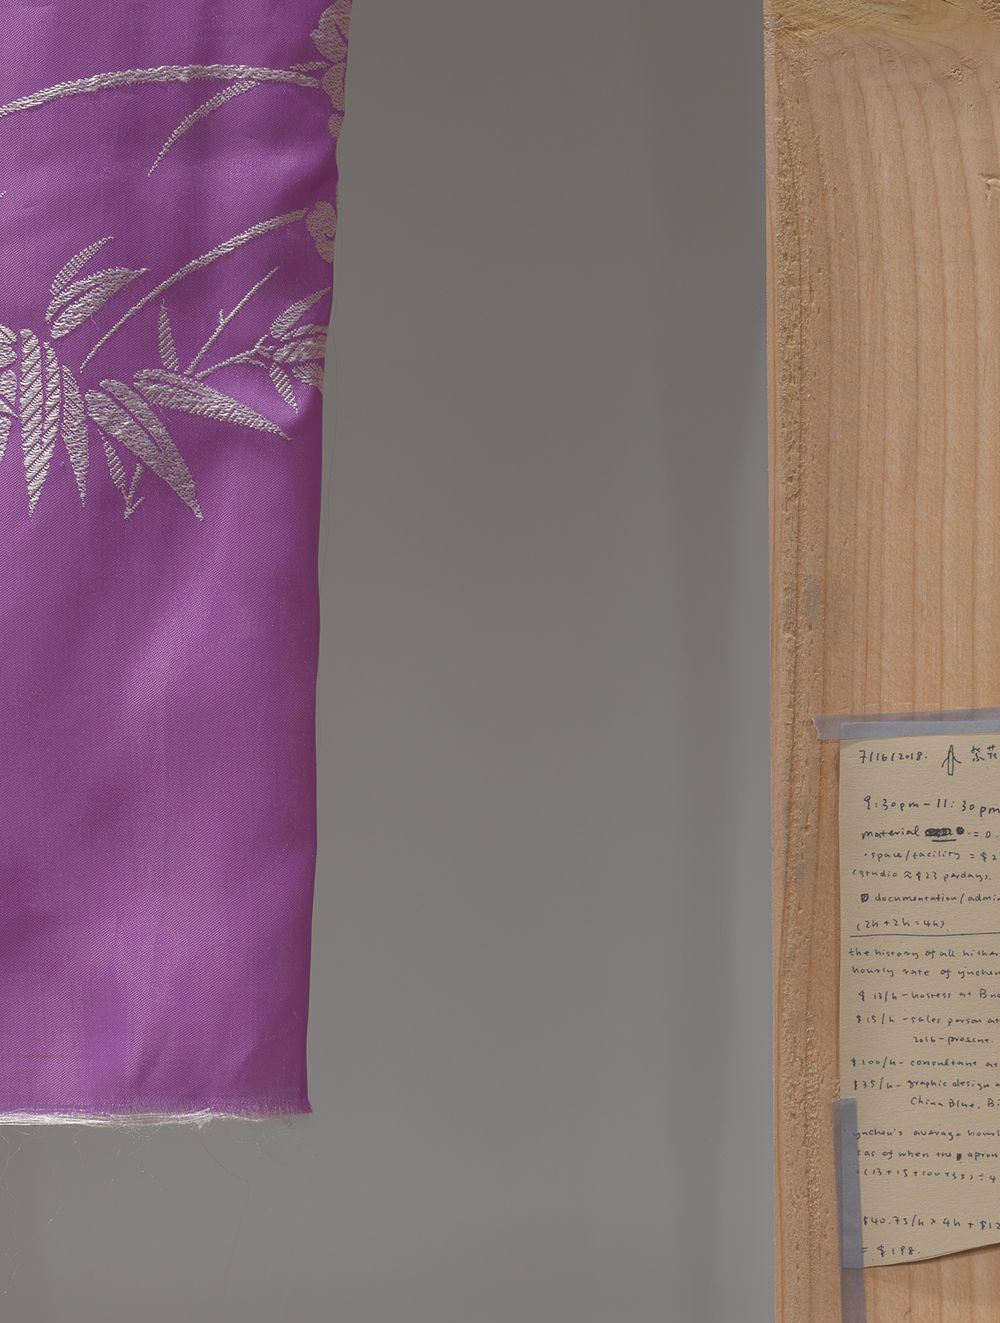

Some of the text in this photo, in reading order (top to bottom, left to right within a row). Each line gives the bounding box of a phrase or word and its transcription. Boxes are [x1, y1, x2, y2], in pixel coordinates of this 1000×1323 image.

[862, 825, 920, 840] material
[849, 947, 869, 957] the
[875, 949, 919, 959] history
[925, 950, 936, 959] of
[940, 948, 955, 958] all
[852, 966, 894, 977] hourly
[903, 968, 929, 977] rate
[940, 969, 951, 979] of
[959, 991, 971, 999] at
[948, 1017, 981, 1027] person
[910, 1058, 976, 1067] consultant
[907, 1080, 947, 1089] graphic
[952, 1079, 989, 1090] design
[882, 1150, 893, 1160] of
[898, 1149, 929, 1158] when
[968, 1152, 998, 1161] apron
